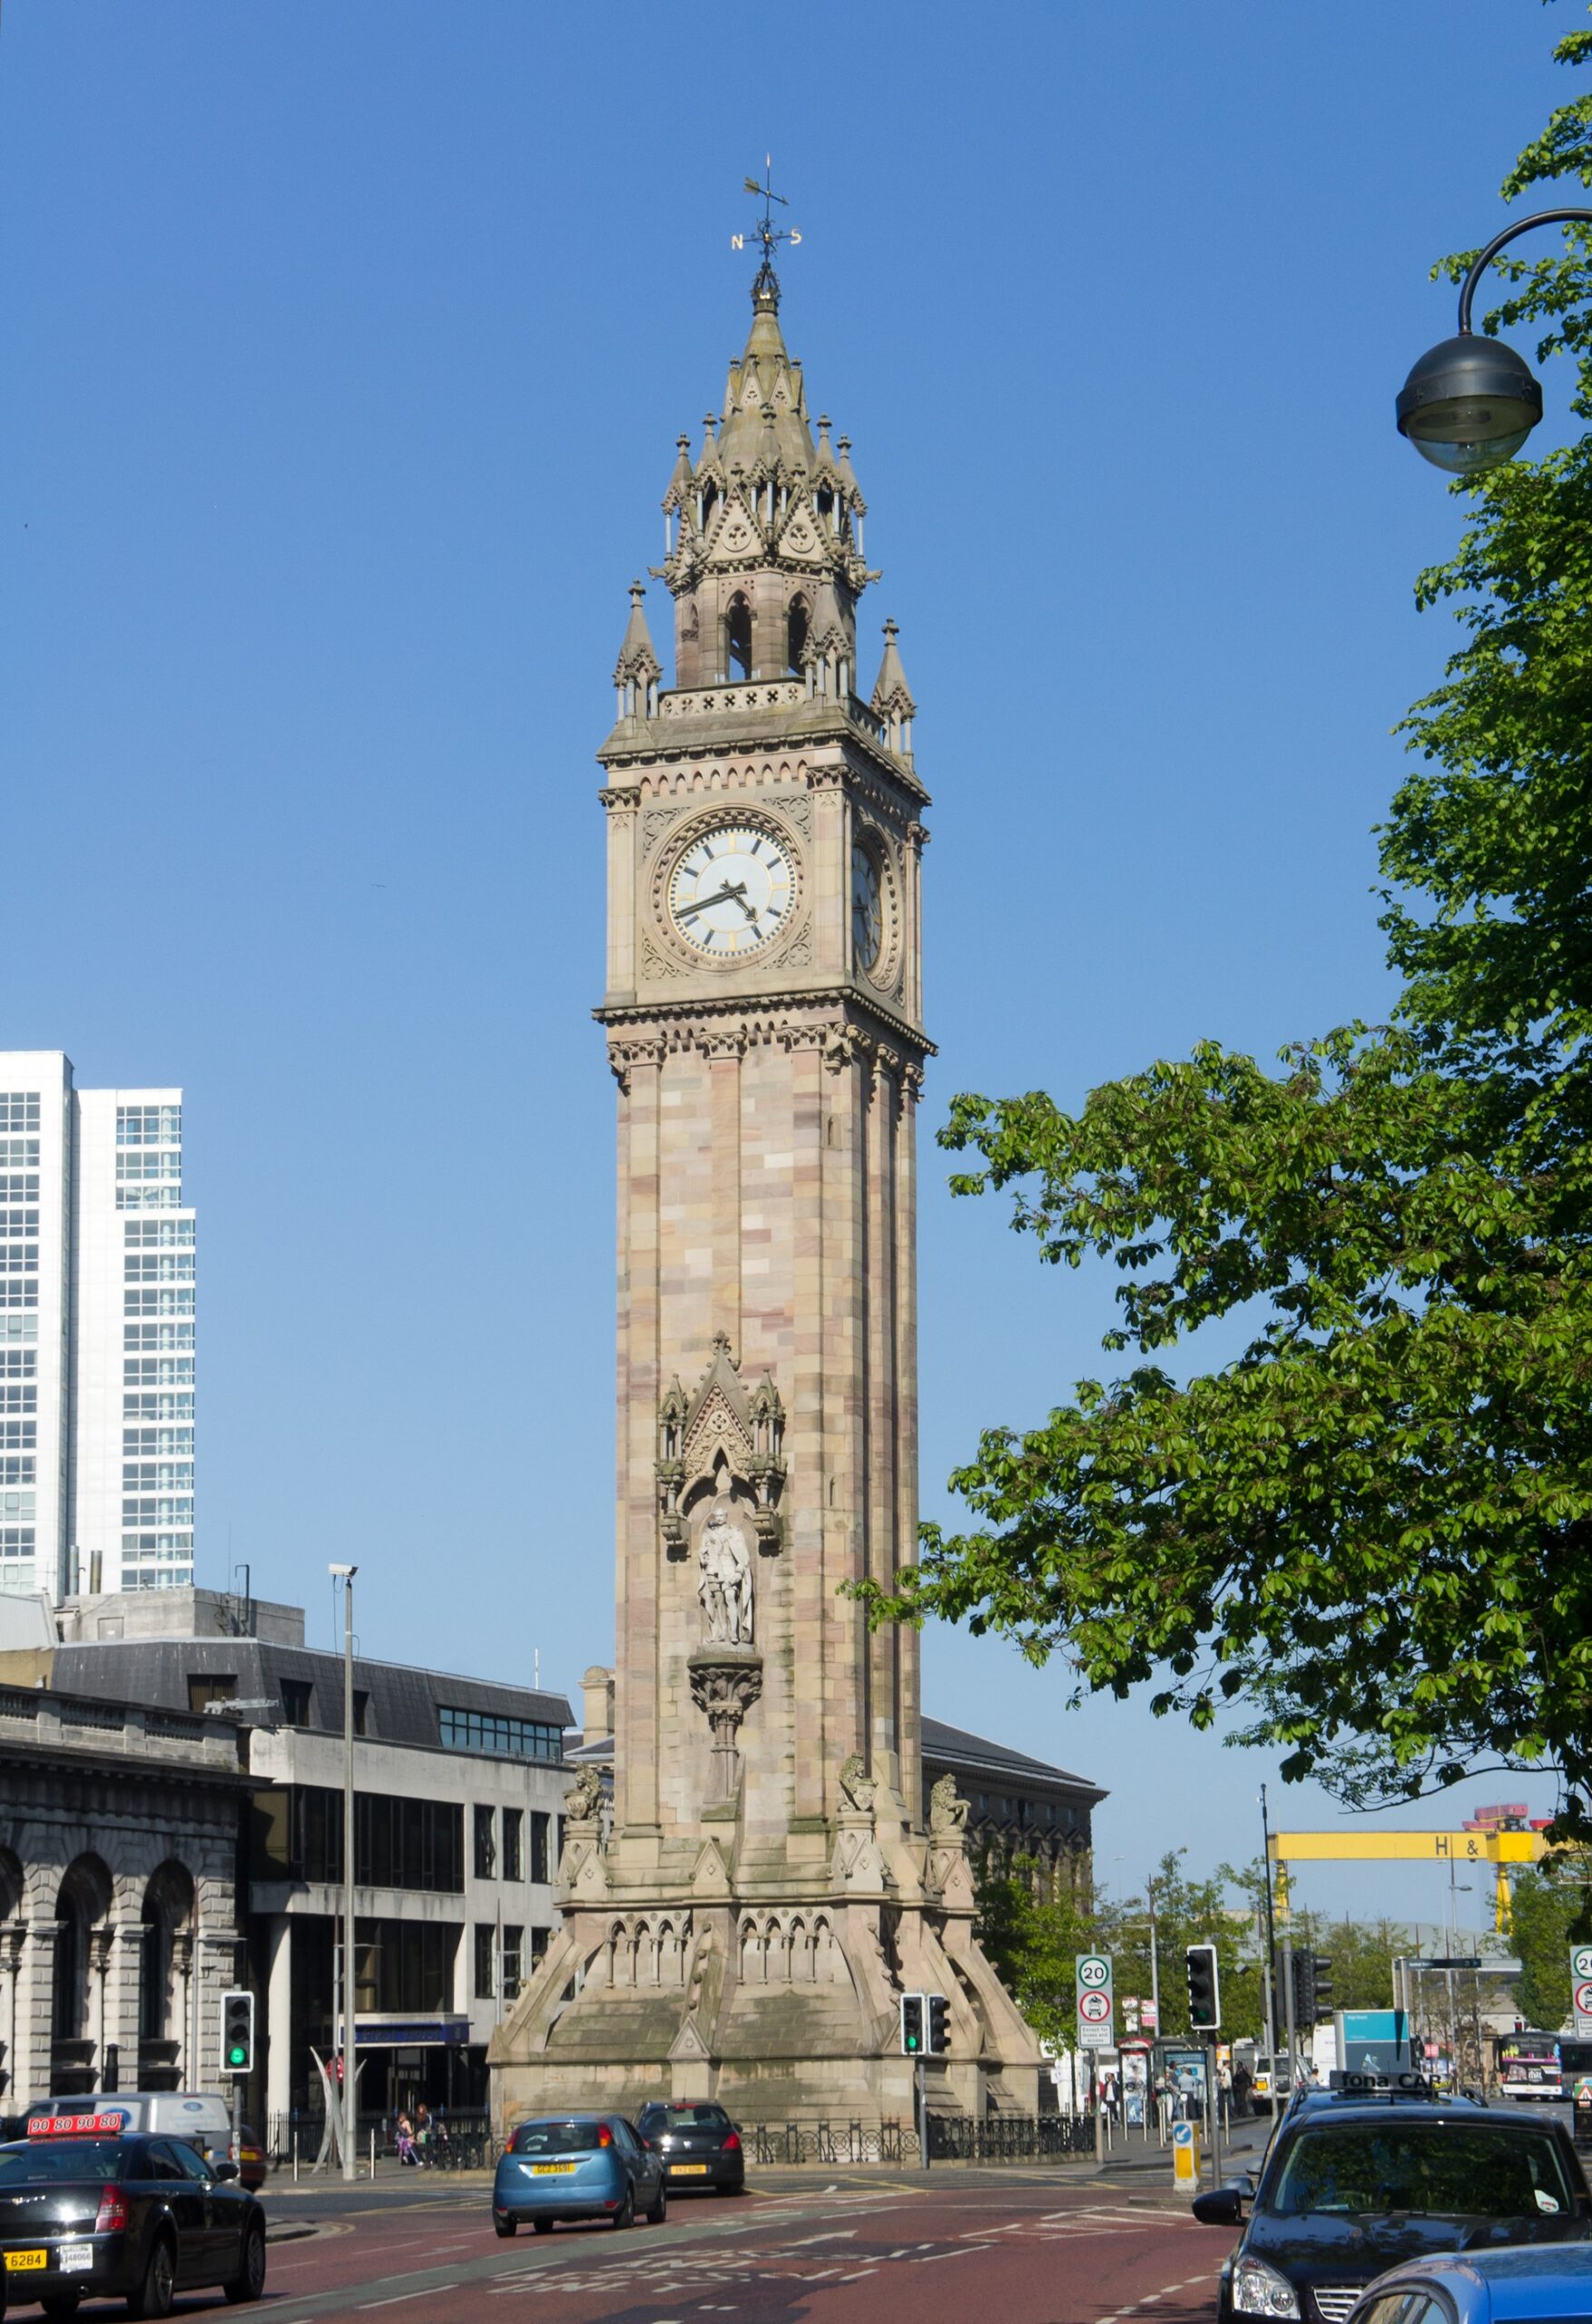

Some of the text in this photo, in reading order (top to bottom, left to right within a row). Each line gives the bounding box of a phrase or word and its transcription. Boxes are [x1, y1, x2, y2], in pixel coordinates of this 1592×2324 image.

[732, 227, 802, 250] N S
[1436, 1836, 1479, 1856] H &
[1579, 1957, 1592, 1970] 2
[1084, 1967, 1105, 1979] 20
[1343, 2073, 1390, 2087] fona
[32, 2115, 117, 2132] 90 80 90 80
[11, 2254, 42, 2267] 6284
